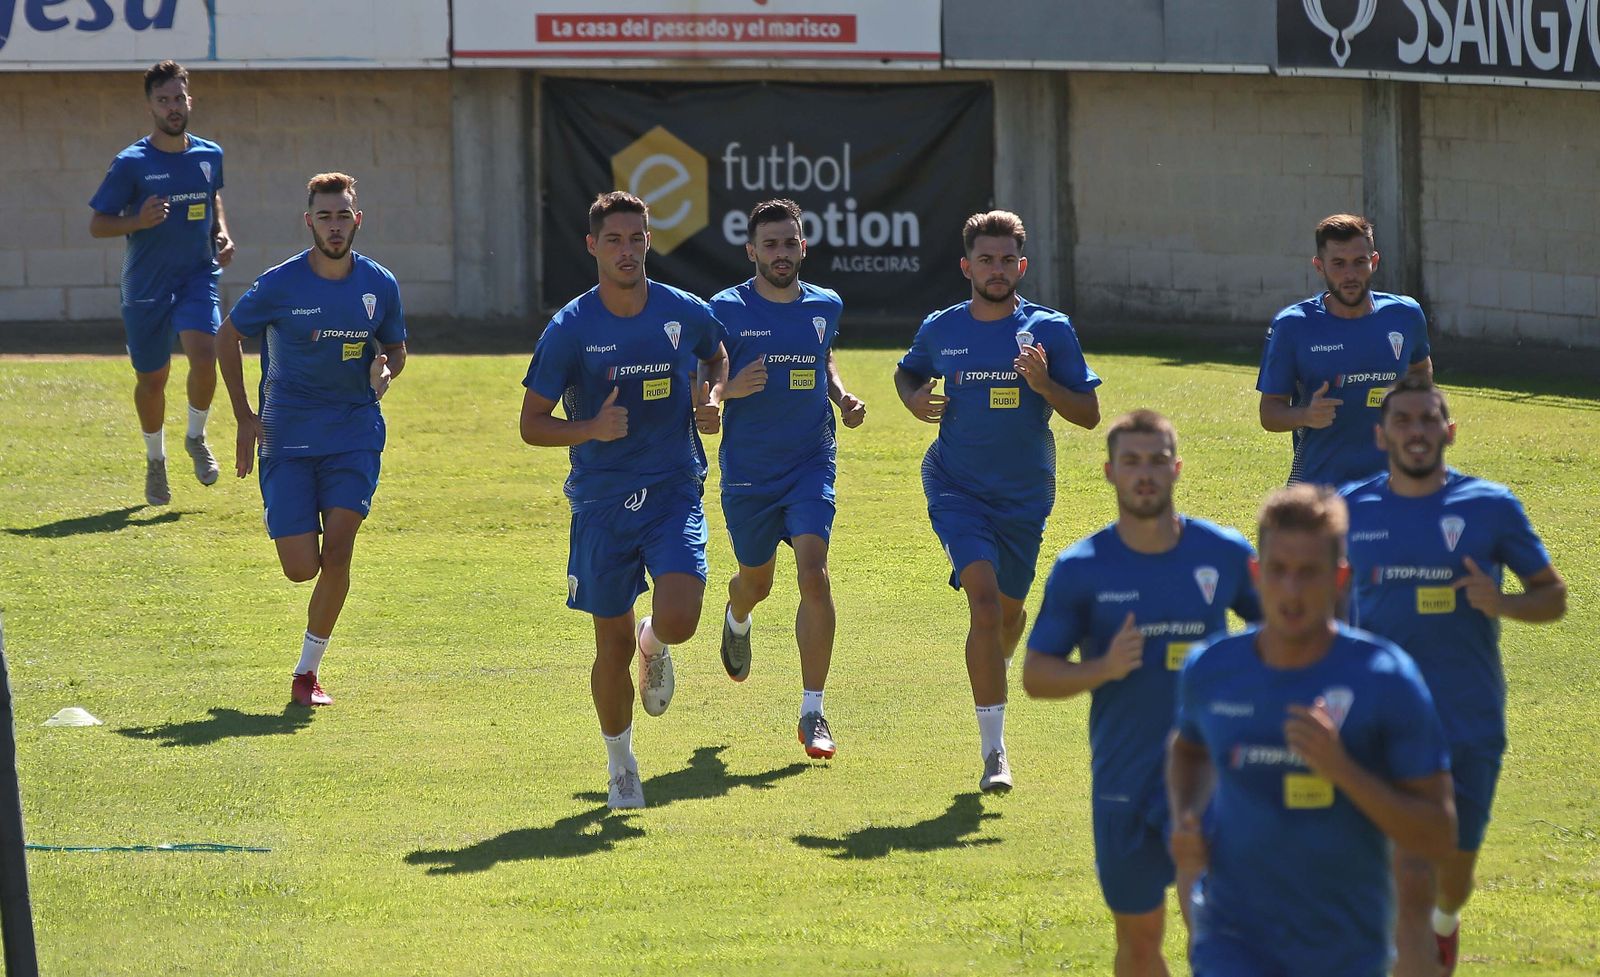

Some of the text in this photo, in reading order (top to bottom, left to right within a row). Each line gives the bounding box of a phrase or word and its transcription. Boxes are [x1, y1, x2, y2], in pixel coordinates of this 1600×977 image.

[552, 18, 841, 40] La casa del pescado y el marisco
[722, 141, 851, 191] futbol
[722, 198, 920, 247] eotion
[831, 255, 920, 273] ALGECIRAS
[291, 307, 322, 316] uhlsport
[322, 330, 369, 338] STOP-FLUID
[740, 329, 772, 338] uhlsport
[585, 343, 617, 354] uhlsport
[940, 347, 969, 357] uhlsport
[1310, 343, 1344, 353] uhlsport
[768, 354, 816, 364] STOP-FLUID
[620, 363, 671, 376] STOP-FLUID
[965, 371, 1018, 381] STOP-FLUID
[1347, 372, 1397, 384] STOP-FLUID
[646, 388, 668, 397] RUBIX
[992, 397, 1017, 406] RUBIX
[1385, 566, 1453, 580] STOP-FLUID
